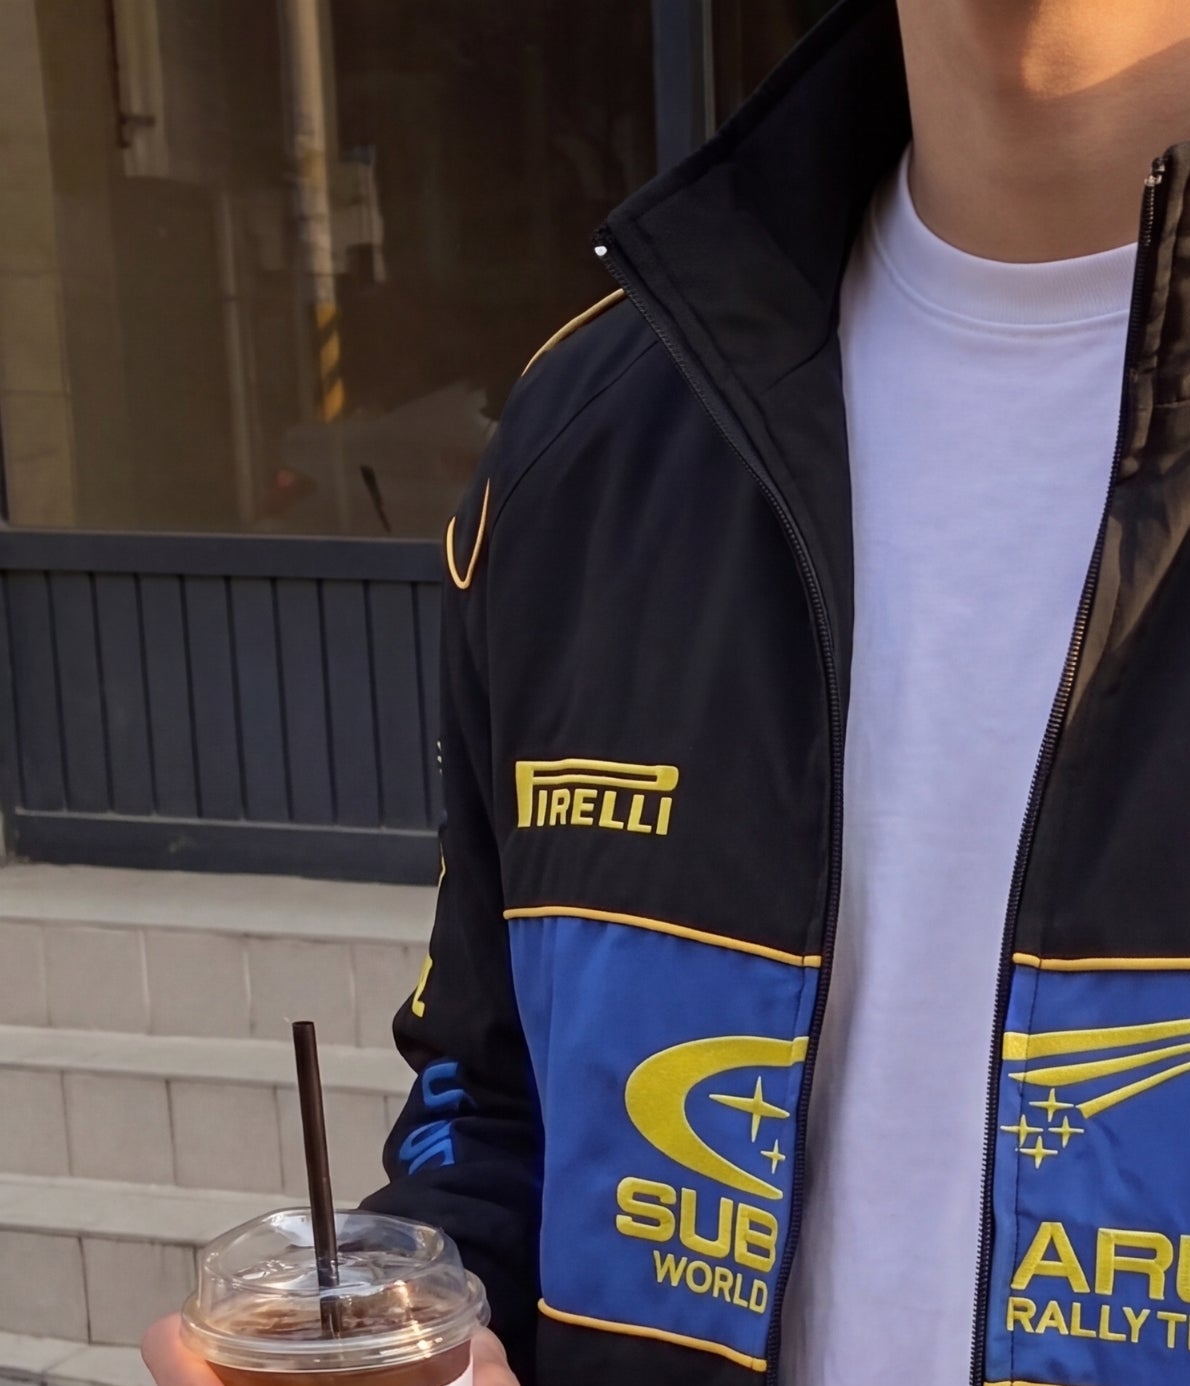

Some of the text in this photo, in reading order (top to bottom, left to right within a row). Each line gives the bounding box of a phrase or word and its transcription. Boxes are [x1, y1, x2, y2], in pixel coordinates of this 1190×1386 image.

[515, 758, 680, 836] PIRELLI
[615, 1176, 779, 1273] SUB
[653, 1250, 769, 1315] WORLD
[1006, 1297, 1151, 1344] RALLY
